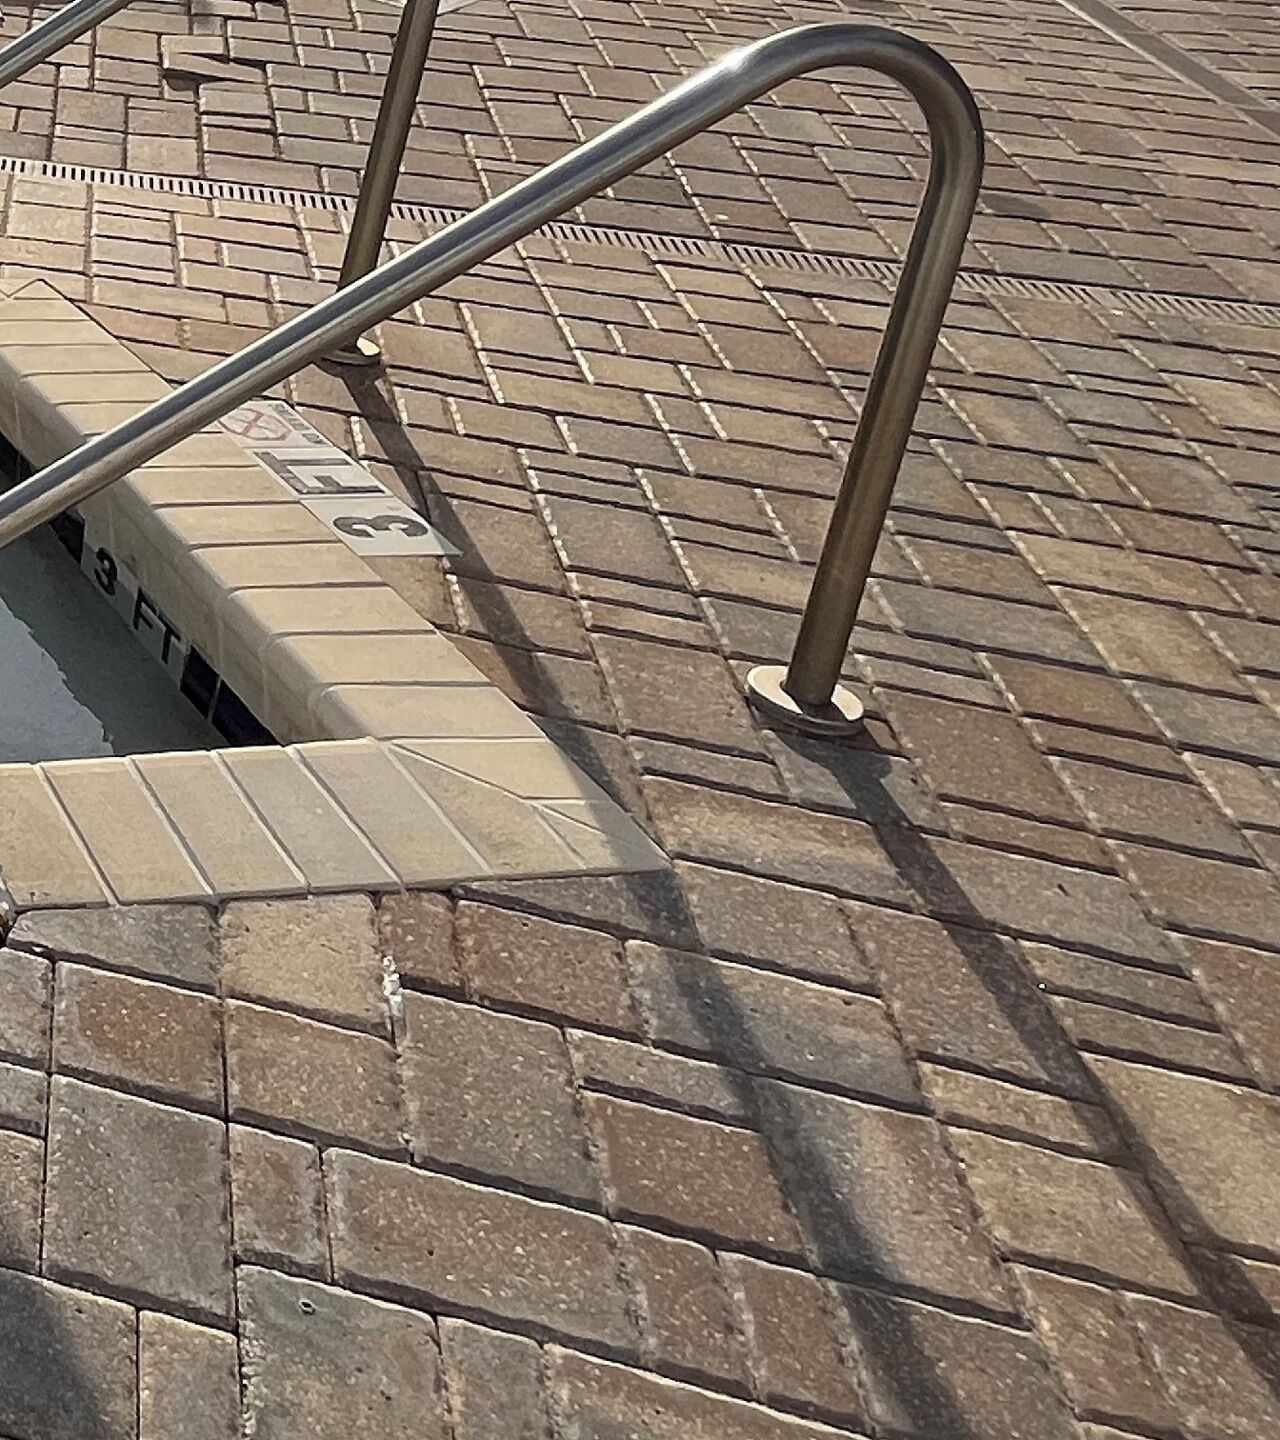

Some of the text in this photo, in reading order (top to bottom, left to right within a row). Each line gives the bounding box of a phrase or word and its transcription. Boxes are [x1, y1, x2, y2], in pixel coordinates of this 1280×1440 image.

[253, 451, 429, 539] 3 FT
[94, 547, 181, 664] 3 FT
